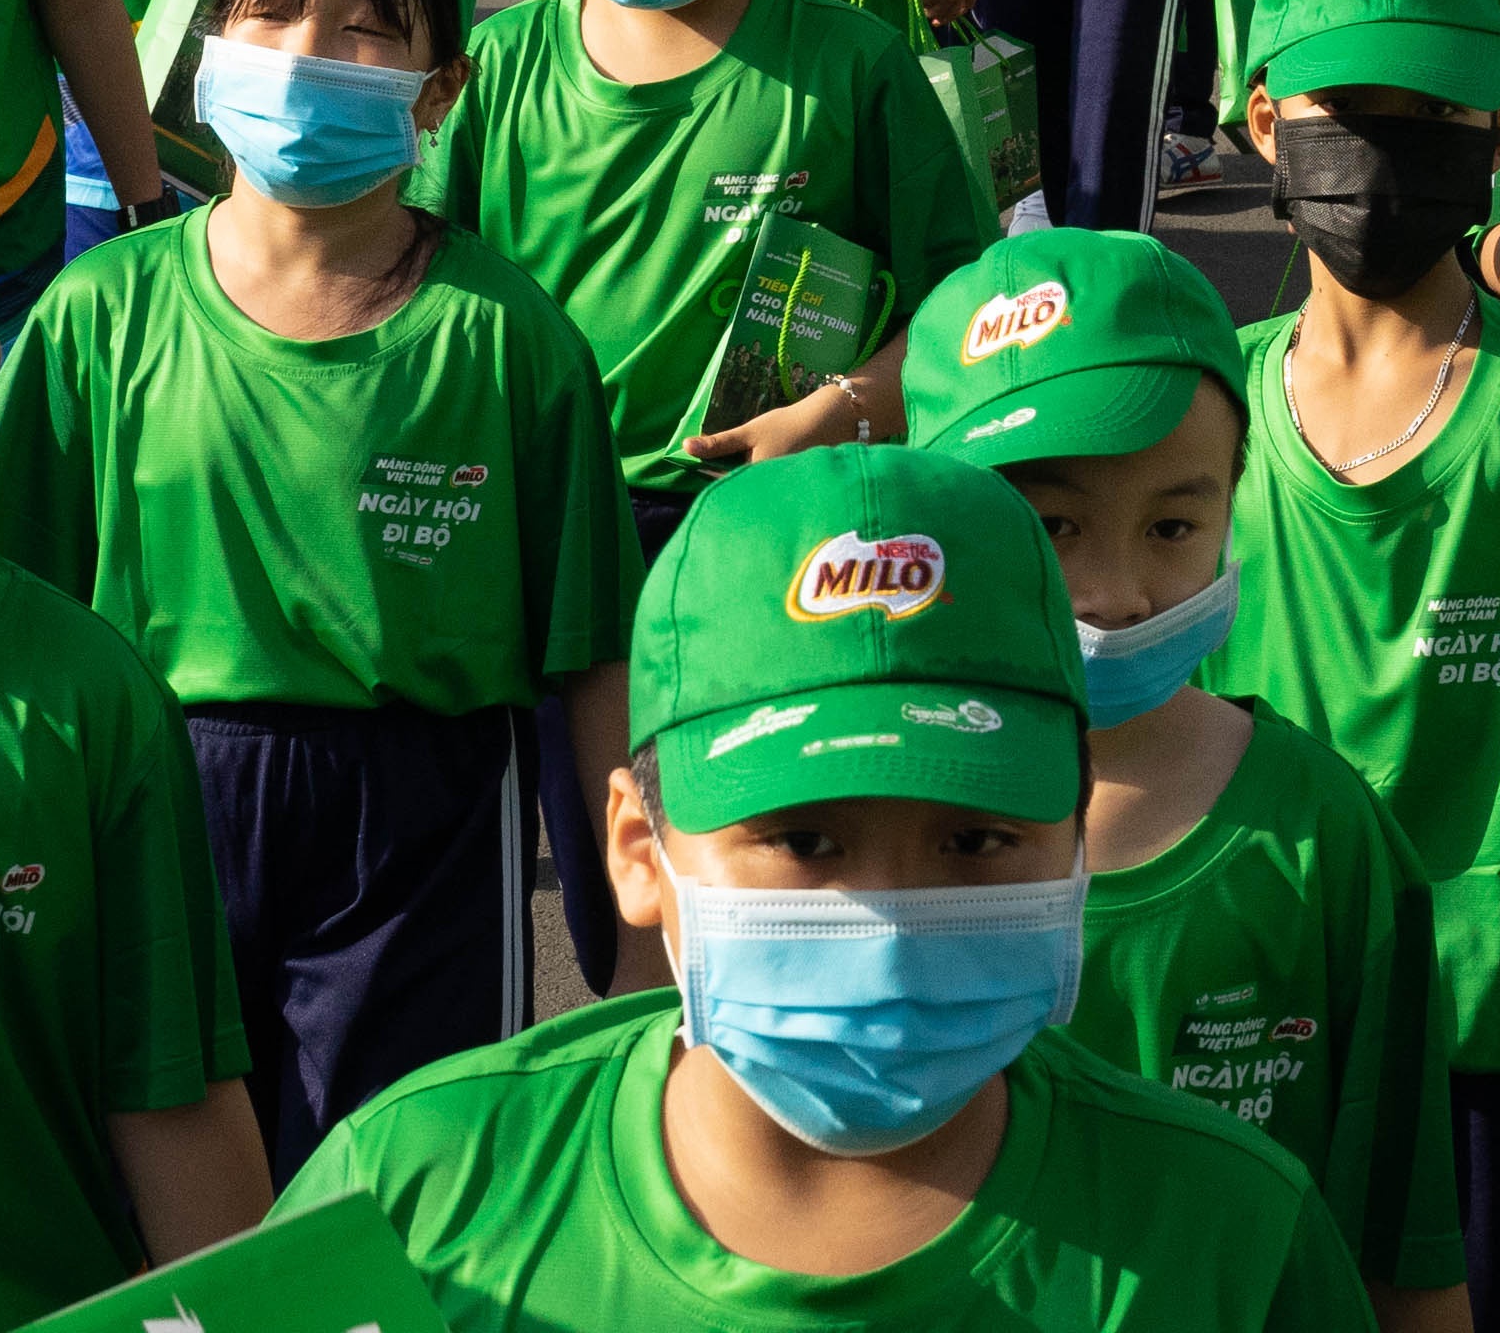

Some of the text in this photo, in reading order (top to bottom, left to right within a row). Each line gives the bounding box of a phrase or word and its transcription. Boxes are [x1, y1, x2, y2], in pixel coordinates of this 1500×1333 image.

[703, 200, 768, 223] NGÀY
[751, 291, 857, 337] CHO TRÌNH
[977, 298, 1057, 348] MILO
[357, 489, 481, 526] NGÀY HỘI
[382, 521, 451, 551] ĐI BỘ
[811, 556, 936, 601] MILO
[1412, 632, 1488, 659] NGÀY
[1438, 661, 1467, 685] ĐI
[1172, 1060, 1250, 1091] NGÀY
